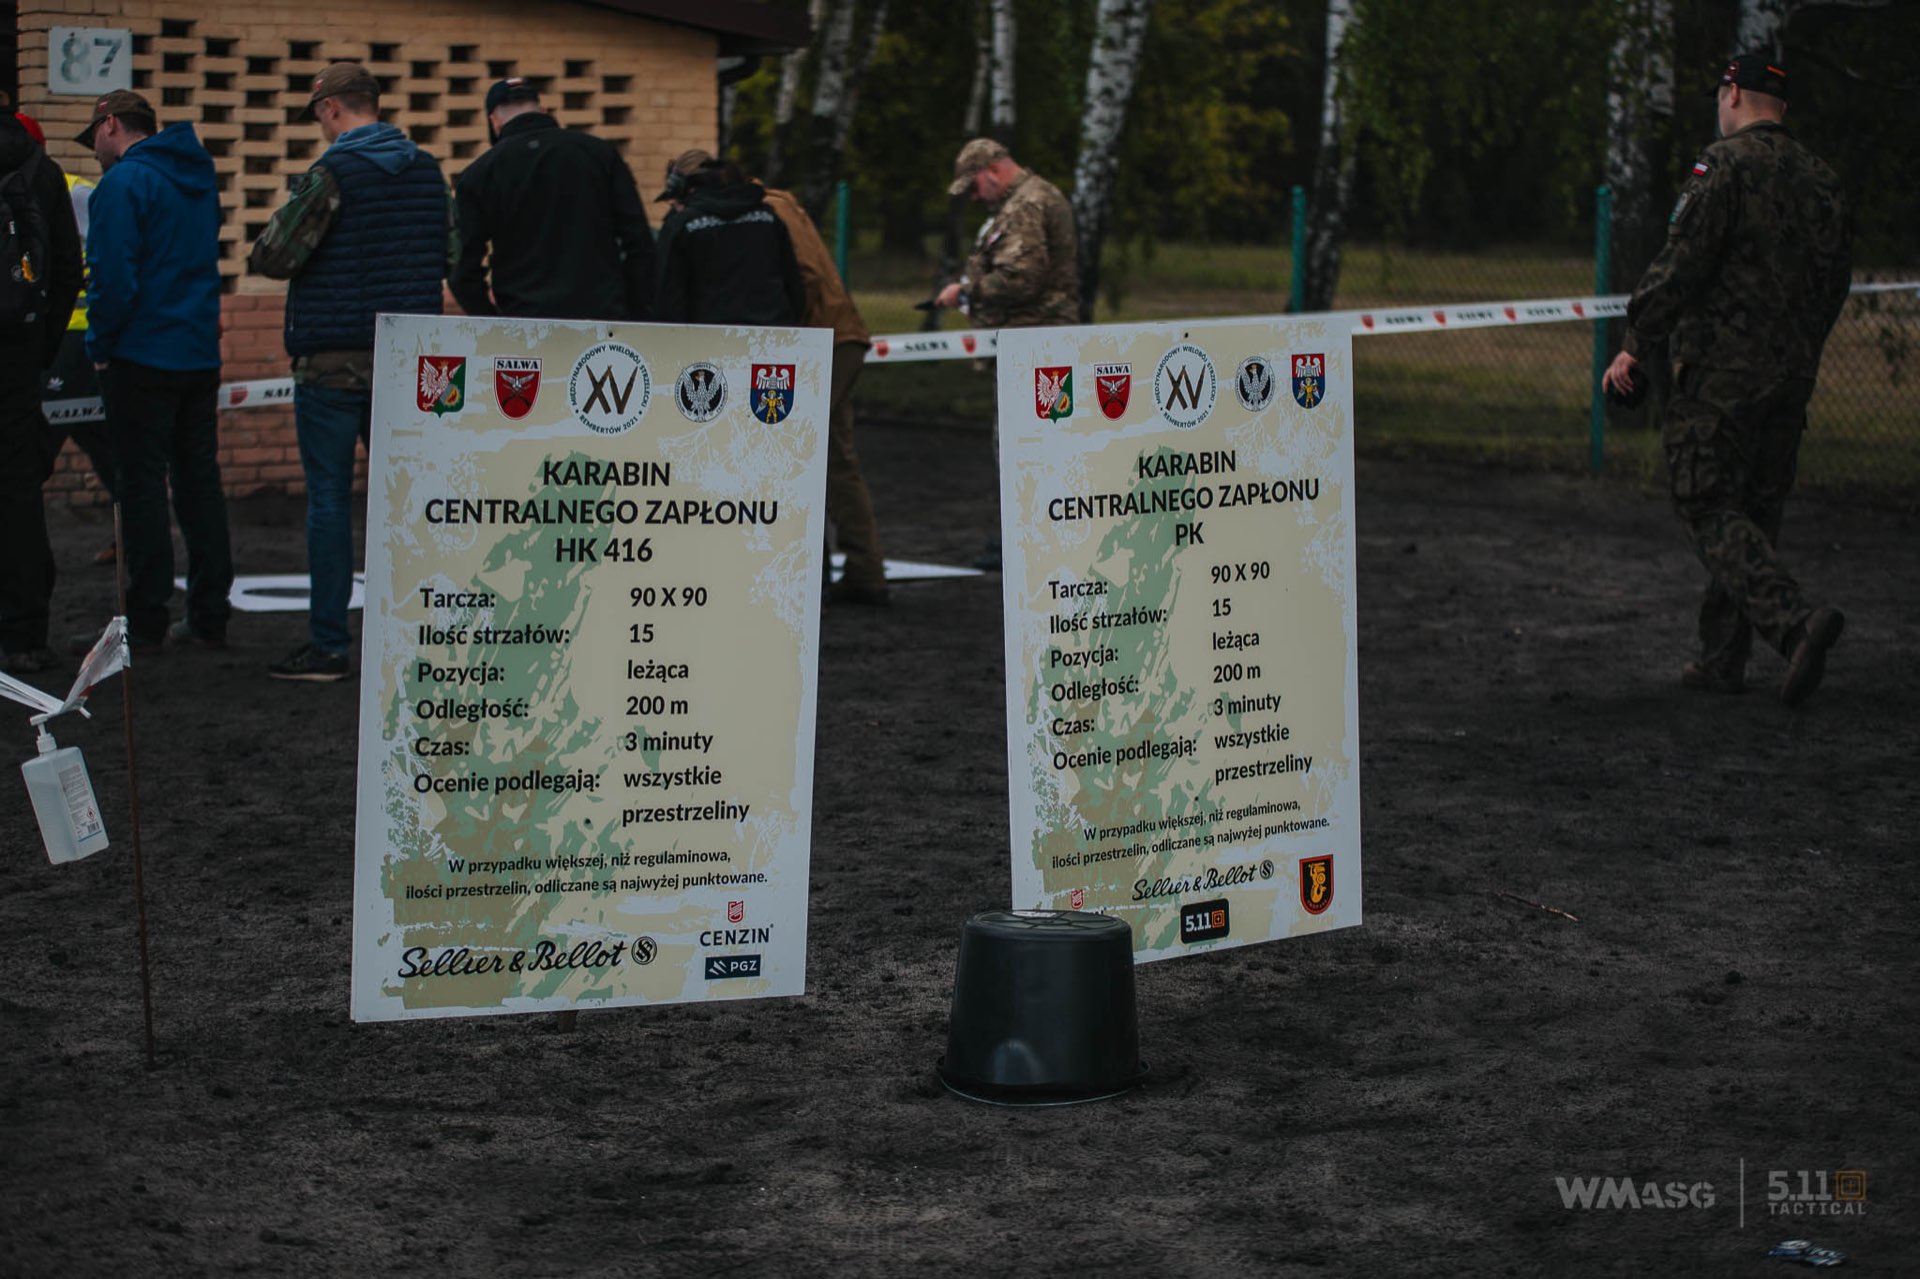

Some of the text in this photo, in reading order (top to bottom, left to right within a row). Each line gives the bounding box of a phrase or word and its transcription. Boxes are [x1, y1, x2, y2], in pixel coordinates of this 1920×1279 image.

[61, 38, 122, 83] 87
[496, 359, 539, 371] SALWA
[609, 344, 641, 365] WIELOBÓJ
[639, 365, 650, 408] STRZELECKI
[1096, 364, 1131, 375] SALWA
[582, 364, 638, 415] XV
[1165, 363, 1206, 411] XV
[579, 415, 638, 434] REMBERTÓW 2021
[543, 462, 671, 486] KARABIN
[1138, 450, 1236, 479] KARABIN
[425, 499, 779, 524] CENTRALNEGO ZAPŁONU
[1049, 478, 1320, 521] CENTRALNEGO ZAPŁONU
[1175, 522, 1204, 547] PK
[556, 538, 653, 562] HK 416
[1048, 561, 1270, 600] Tarcza: 90 X 90
[420, 587, 707, 609] Tarcza: 90 X 90
[1050, 598, 1232, 634] Ilość strzałów: 15
[418, 623, 654, 645] Ilość strzałów: 15
[1051, 630, 1260, 669] Pozycja: leżąca
[418, 659, 689, 686] Pozycja: leżąca
[1051, 663, 1261, 702] Odległość: 200 m
[416, 696, 689, 722] Odległość: 200 m
[1052, 692, 1282, 737] Czas: 3 minuty
[415, 731, 713, 756] Czas: 3 minuty
[1053, 723, 1290, 771] Ocenie podlegają: wszystkie
[414, 766, 722, 795] Ocenie podlegają: wszystkie
[1215, 753, 1313, 786] przestrzeliny
[622, 800, 750, 826] przestrzeliny
[1084, 798, 1301, 842] W przypadku większej, niż regulaminowa,
[1052, 815, 1330, 869] ilości przestrzelin, odliczane są najwyżej punktowane.
[448, 849, 731, 875] W przypadku większej, niż regulaminowa,
[406, 870, 768, 900] ilości przestrzelin, odliczane są najwyżej punktowane.
[1132, 863, 1258, 901] Sellier & Bellot
[700, 928, 770, 946] CENZIN
[1185, 915, 1212, 933] 5.11
[398, 939, 627, 978] Sellier & Bellot
[730, 958, 758, 973] PGZ
